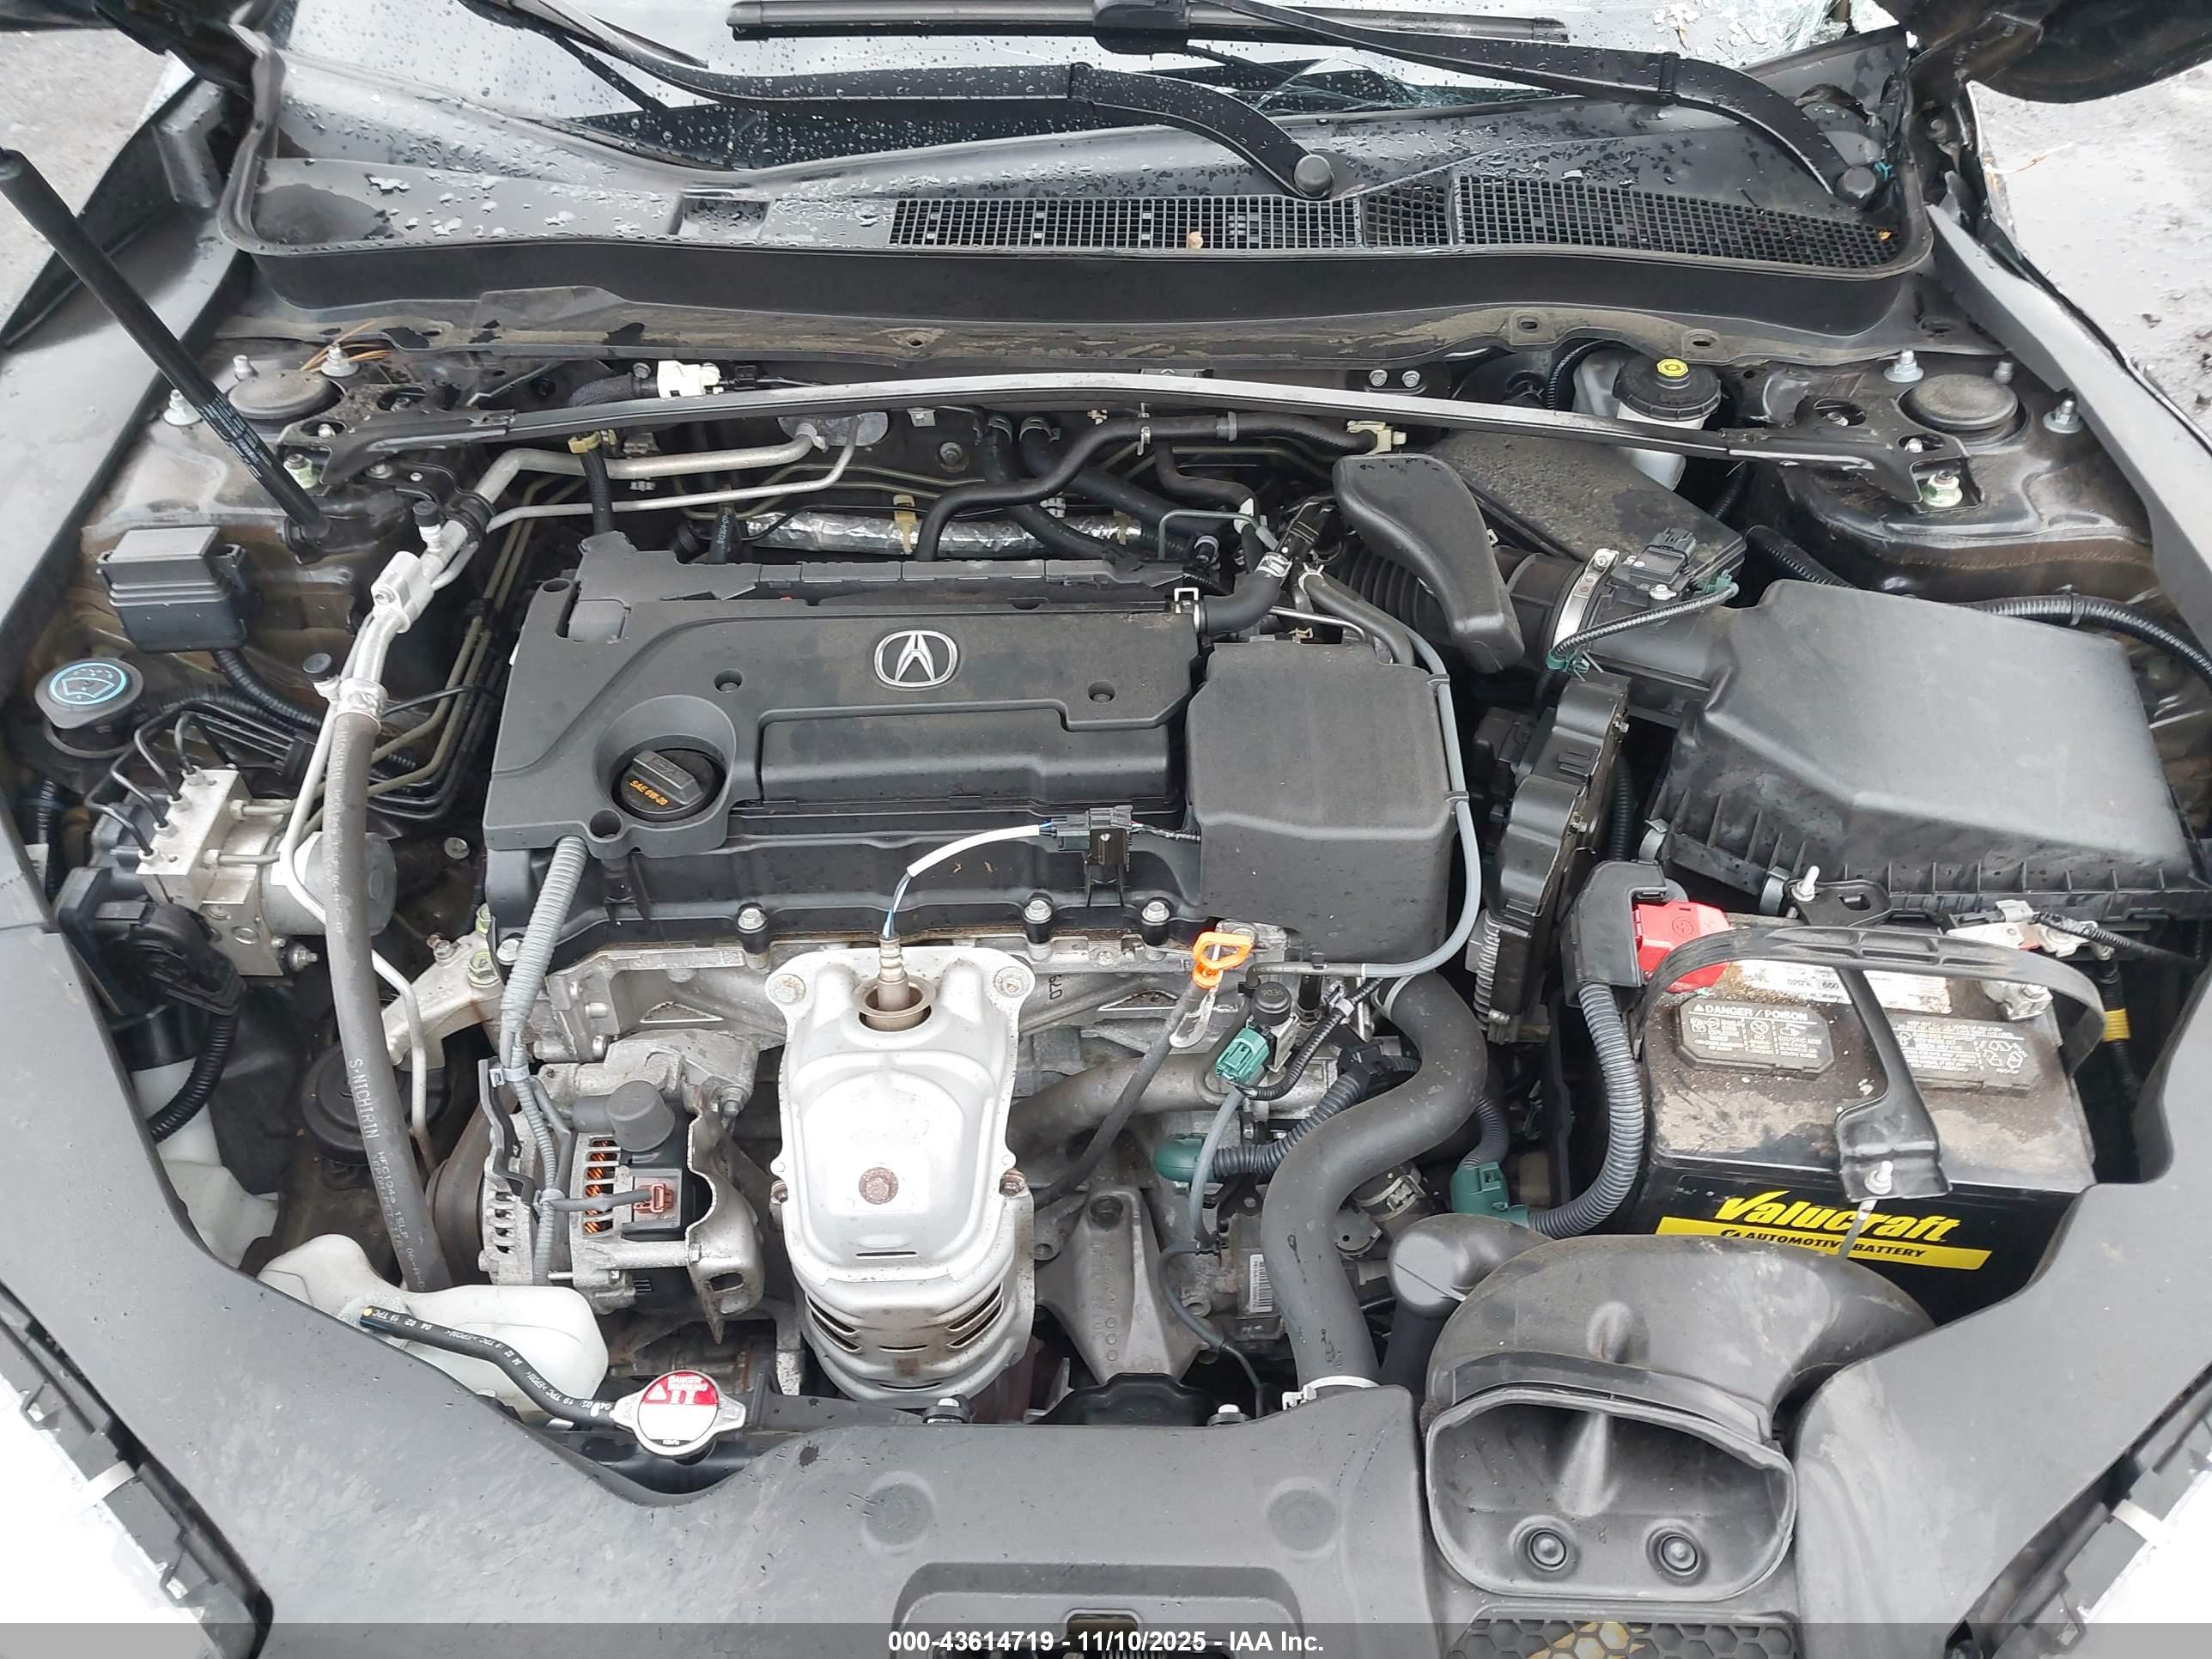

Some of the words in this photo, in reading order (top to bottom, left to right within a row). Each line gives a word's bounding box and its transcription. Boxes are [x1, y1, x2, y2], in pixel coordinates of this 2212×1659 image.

[629, 780, 648, 793] SAE
[1705, 1005, 1753, 1017] DANGER
[1765, 1010, 1808, 1021] POISON
[1714, 1190, 1961, 1243] Valucraft
[1744, 1231, 1844, 1249] AUTOMOTIV
[1852, 1243, 1928, 1258] BATTERY
